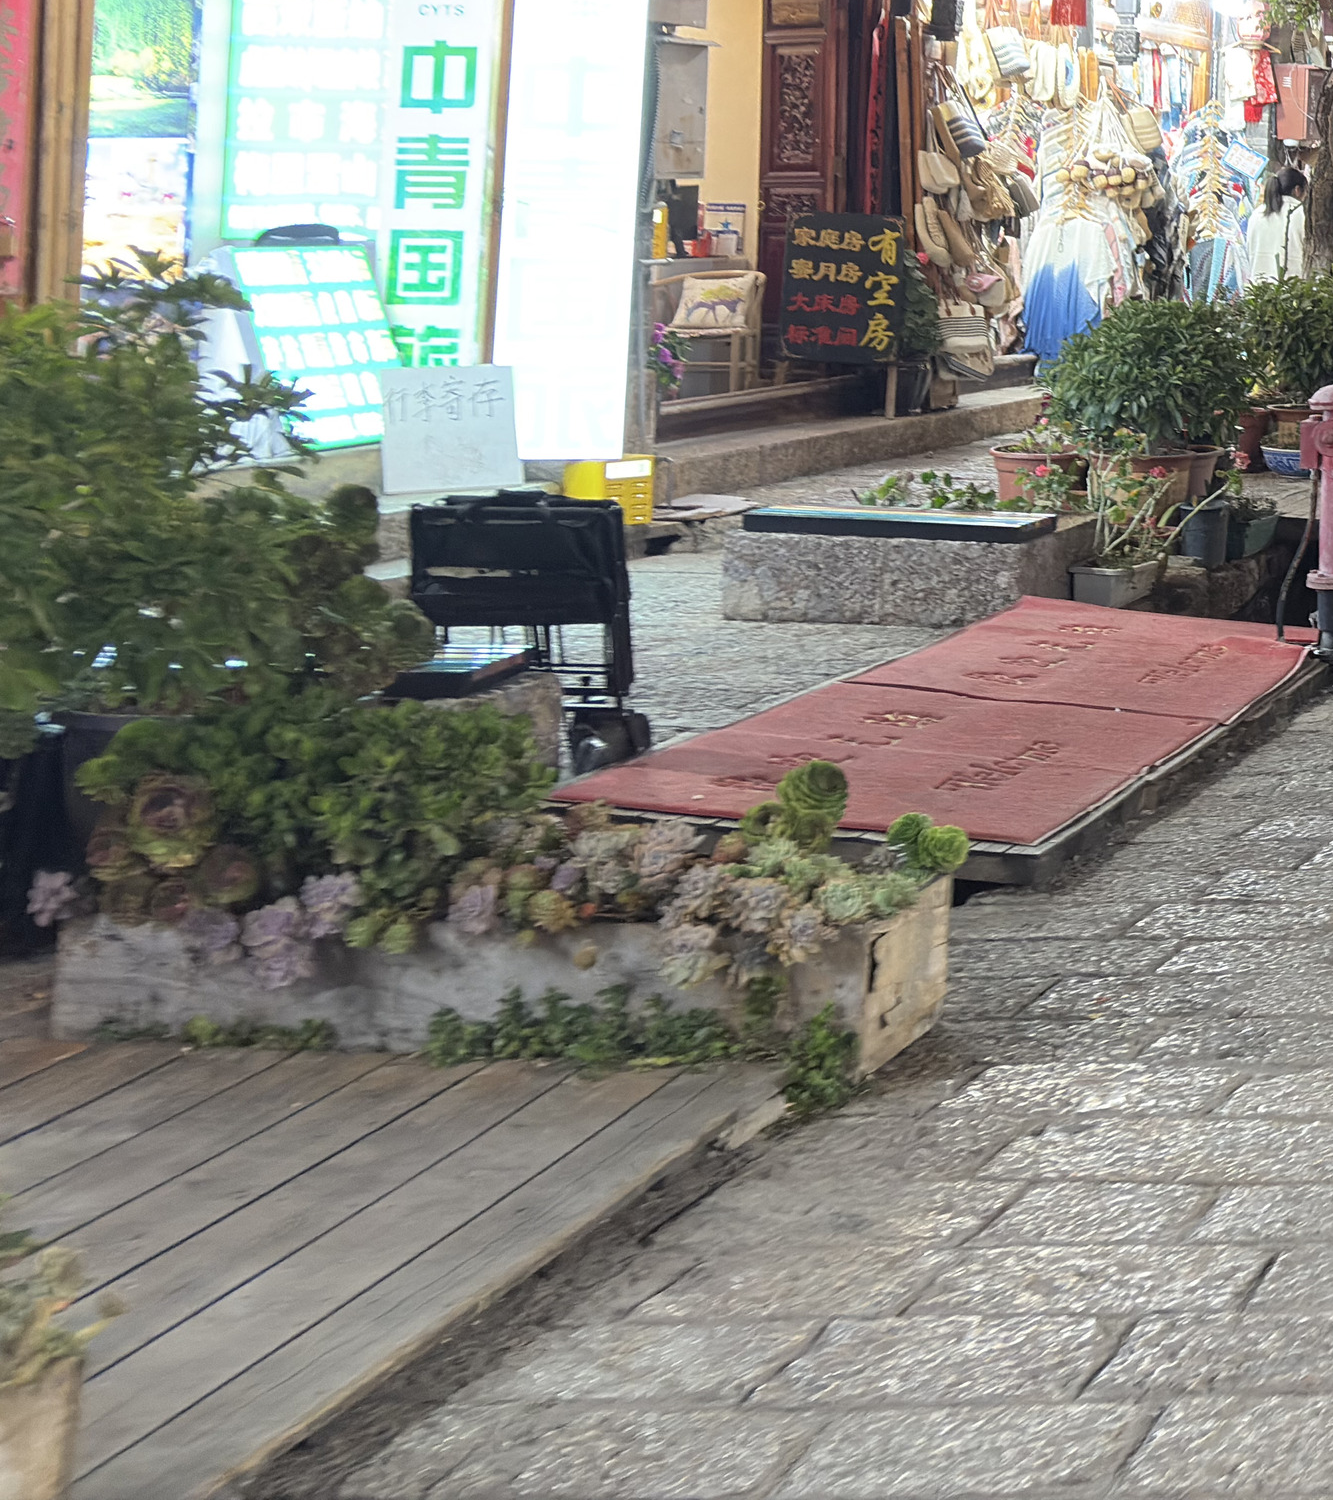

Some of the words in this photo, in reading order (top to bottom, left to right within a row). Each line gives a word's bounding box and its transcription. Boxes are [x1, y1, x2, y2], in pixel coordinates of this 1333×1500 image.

[418, 4, 464, 16] CYTS
[860, 227, 901, 351] 有空房
[384, 376, 506, 426] 行李寄存
